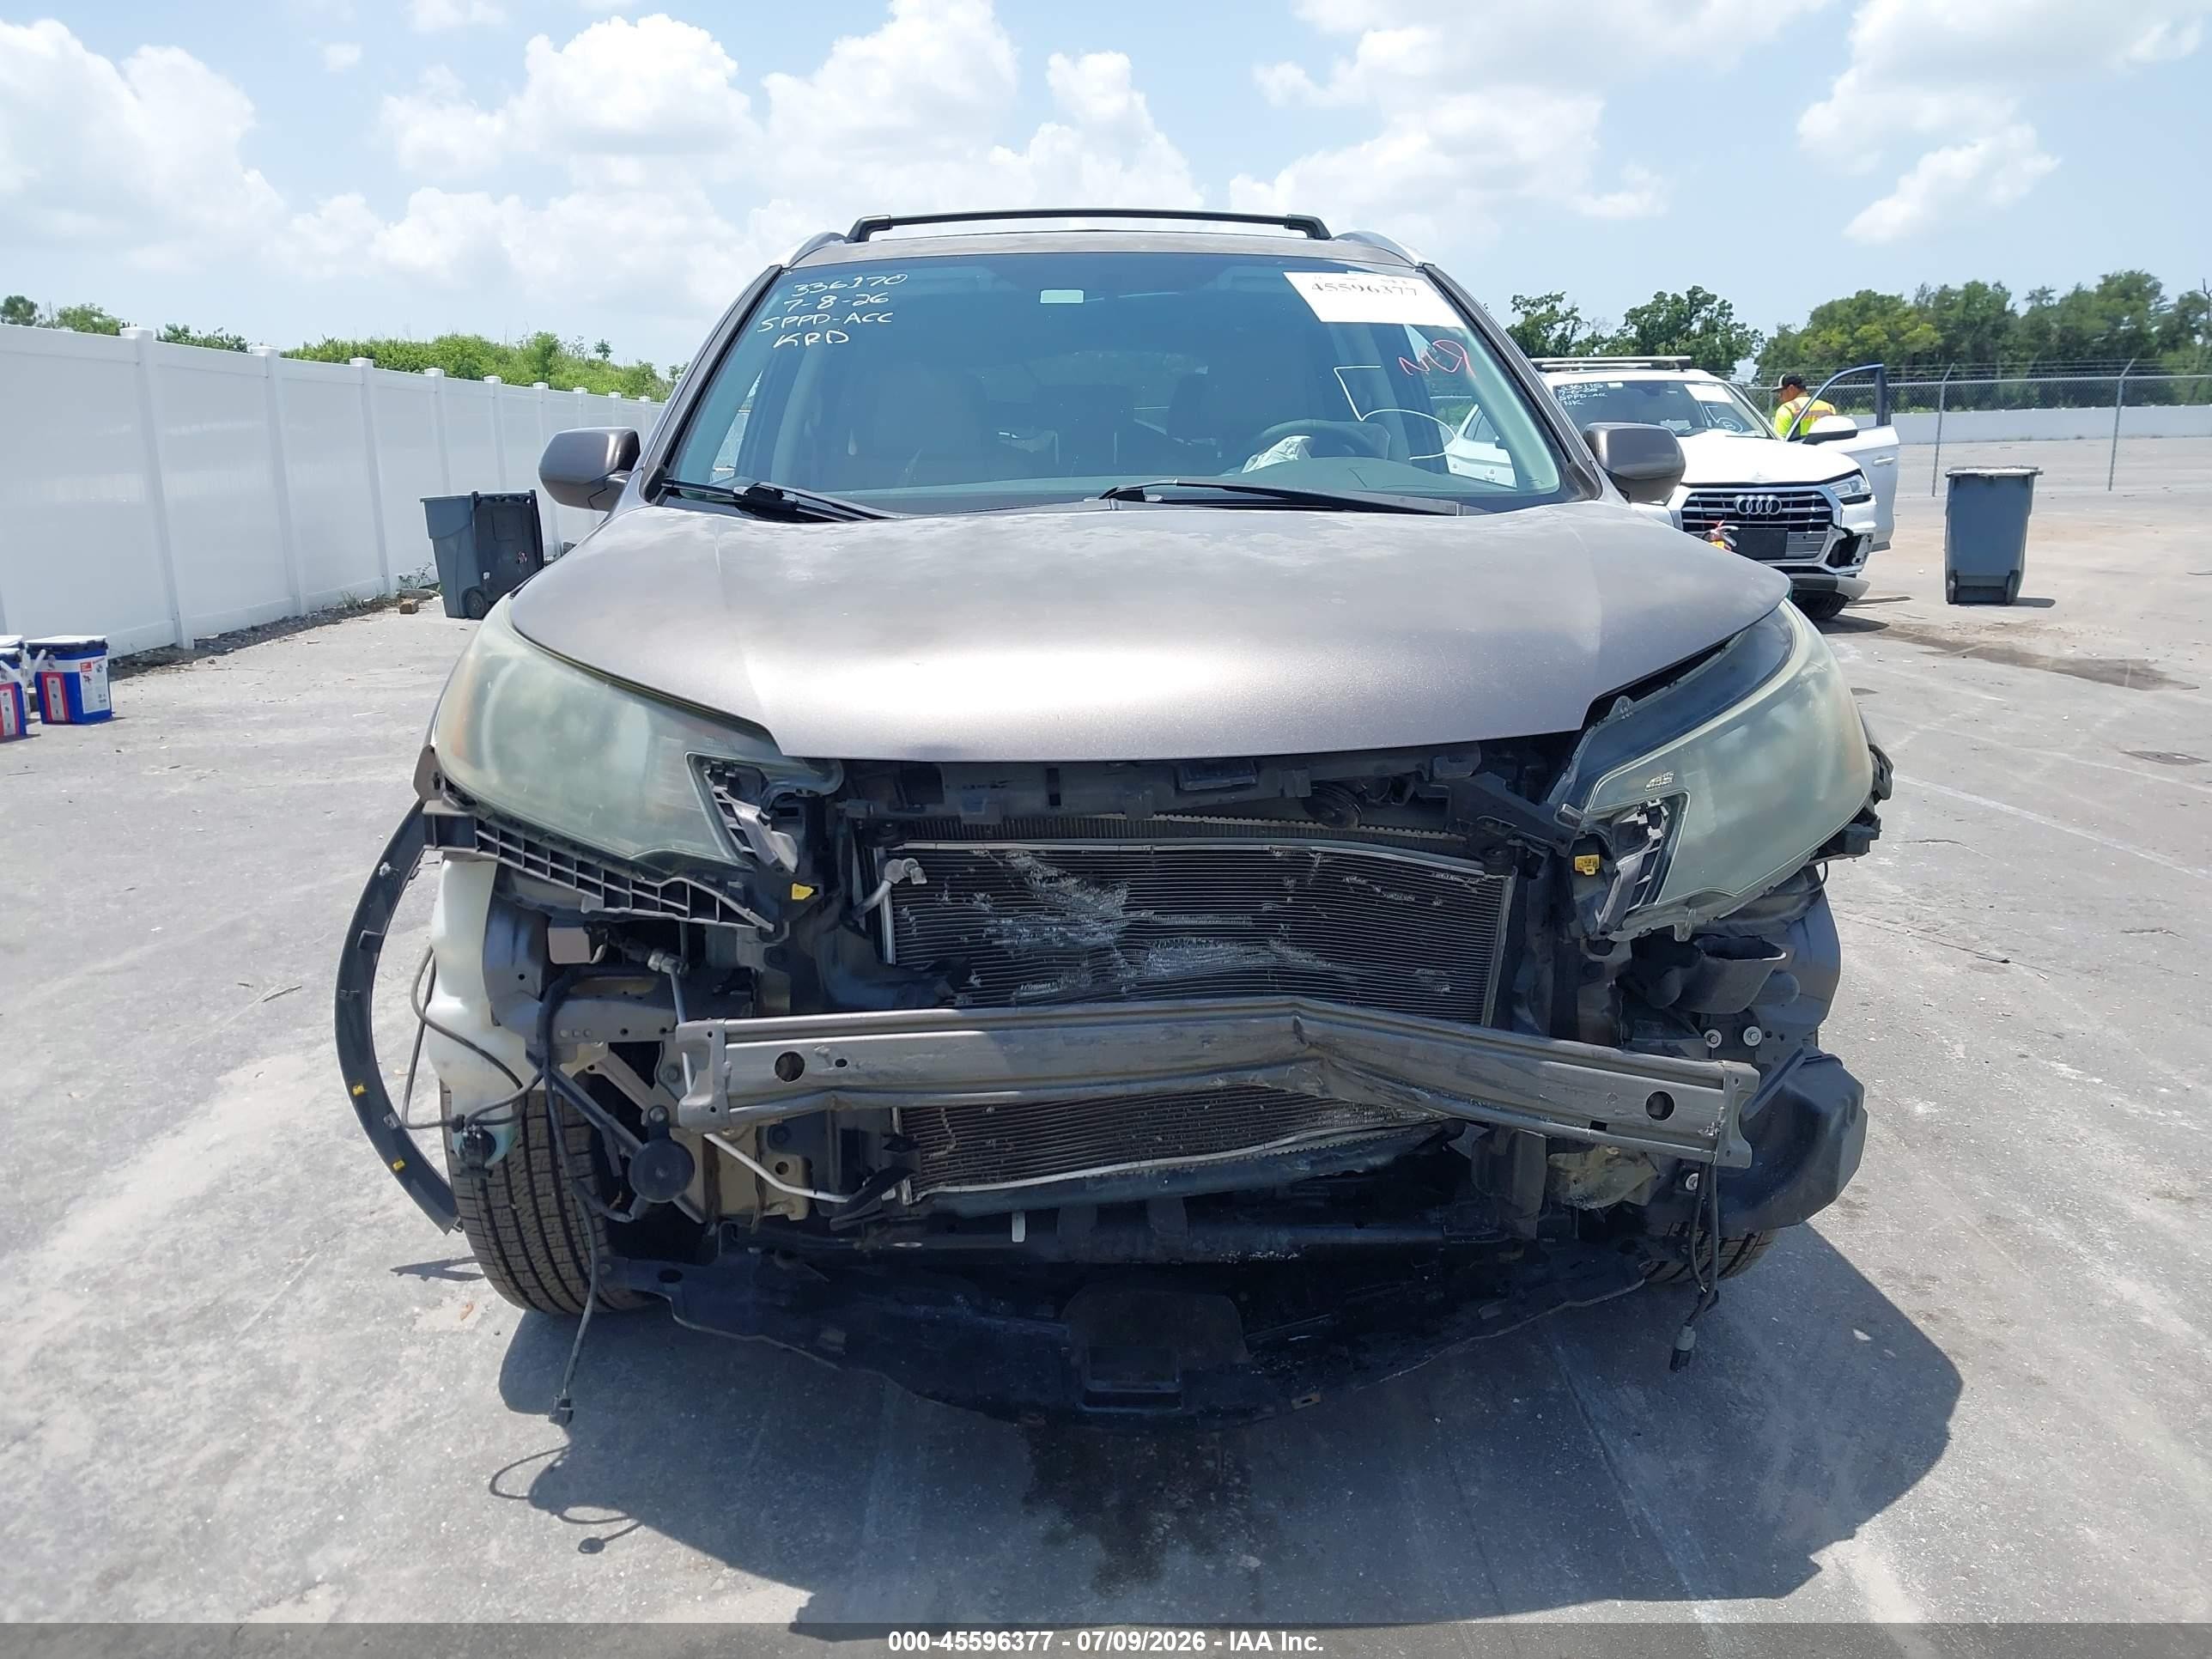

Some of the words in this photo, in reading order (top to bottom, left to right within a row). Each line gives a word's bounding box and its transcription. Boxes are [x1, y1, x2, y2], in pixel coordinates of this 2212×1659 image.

[791, 273, 908, 296] 336170
[1312, 282, 1417, 296] 45596377
[783, 292, 890, 313] 7-8-26
[757, 312, 894, 332] SPPD-ACC
[773, 329, 849, 349] KRD
